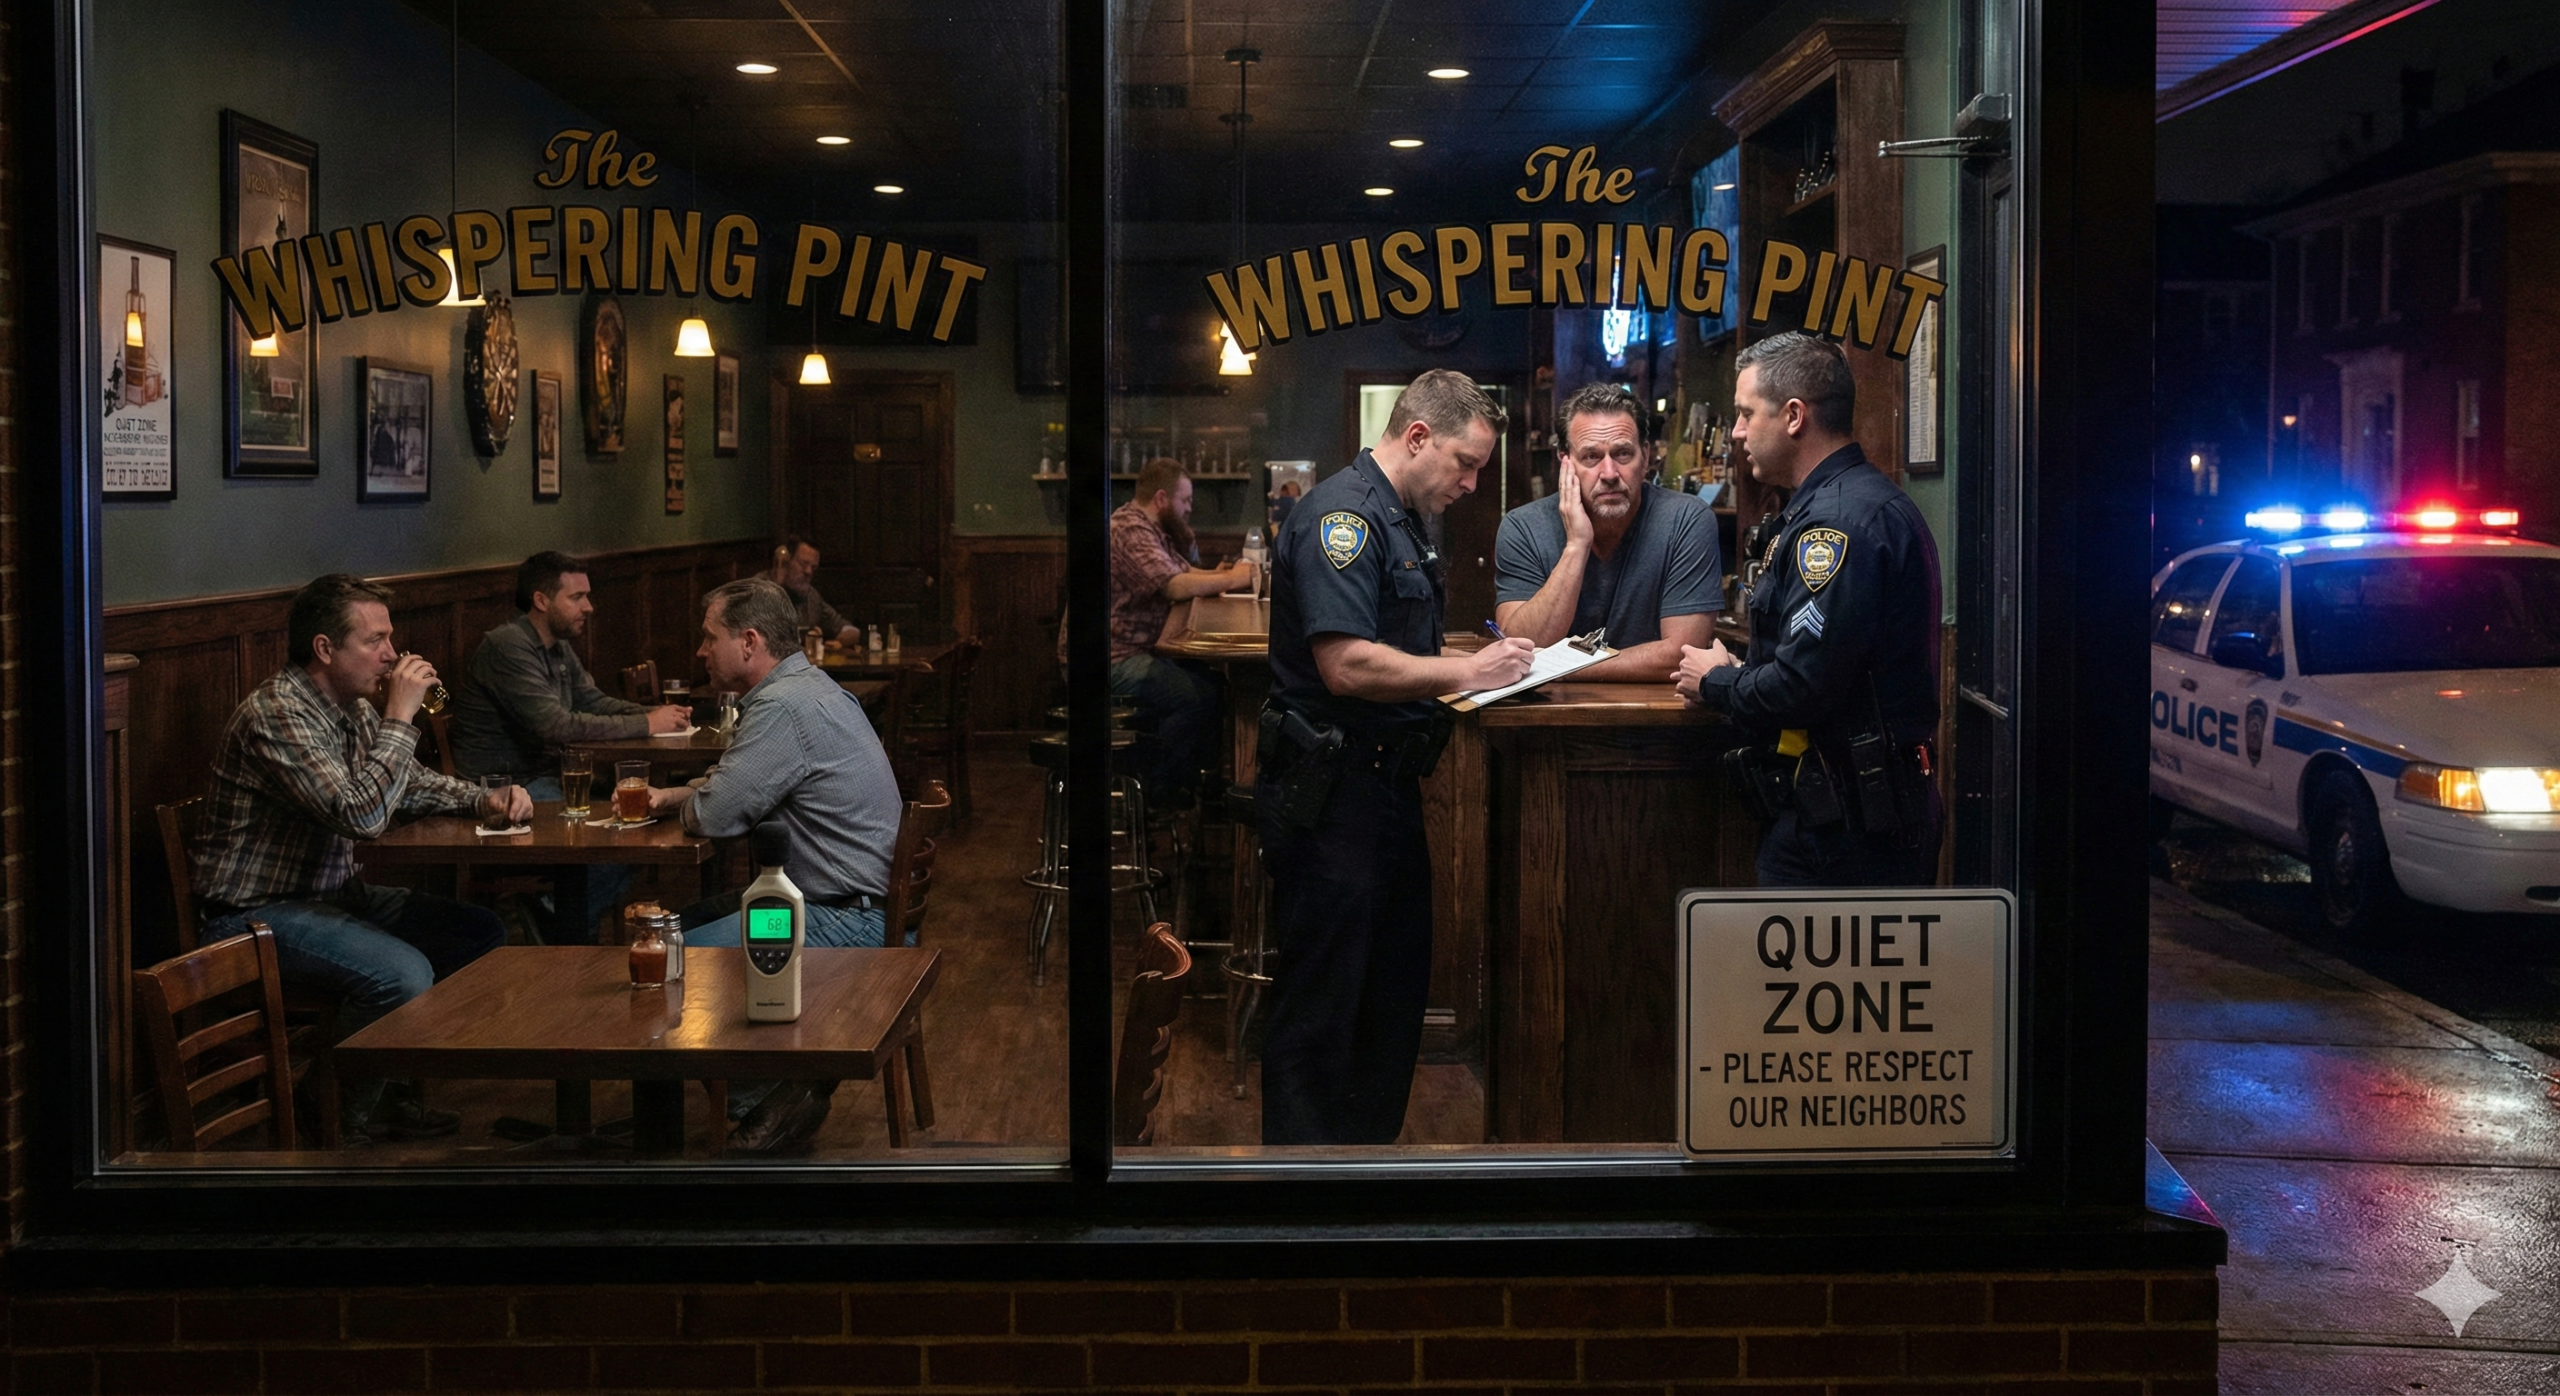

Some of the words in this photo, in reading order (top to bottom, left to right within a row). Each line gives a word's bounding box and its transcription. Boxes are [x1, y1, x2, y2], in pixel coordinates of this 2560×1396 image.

[538, 129, 658, 189] The
[1517, 144, 1636, 203] The
[213, 206, 760, 339] WHISPERING
[786, 223, 987, 344] PINT
[1206, 222, 1730, 354] WHISPERING
[1751, 240, 1947, 359] PINT
[2151, 690, 2239, 757] OLICE
[1757, 914, 1941, 972] QUIET
[1763, 981, 1934, 1034] ZONE
[1724, 1051, 1833, 1083] PLEASE
[1845, 1050, 1974, 1082] RESPECT
[1729, 1096, 1788, 1128] OUR
[1801, 1094, 1966, 1127] NEIGHBORS
